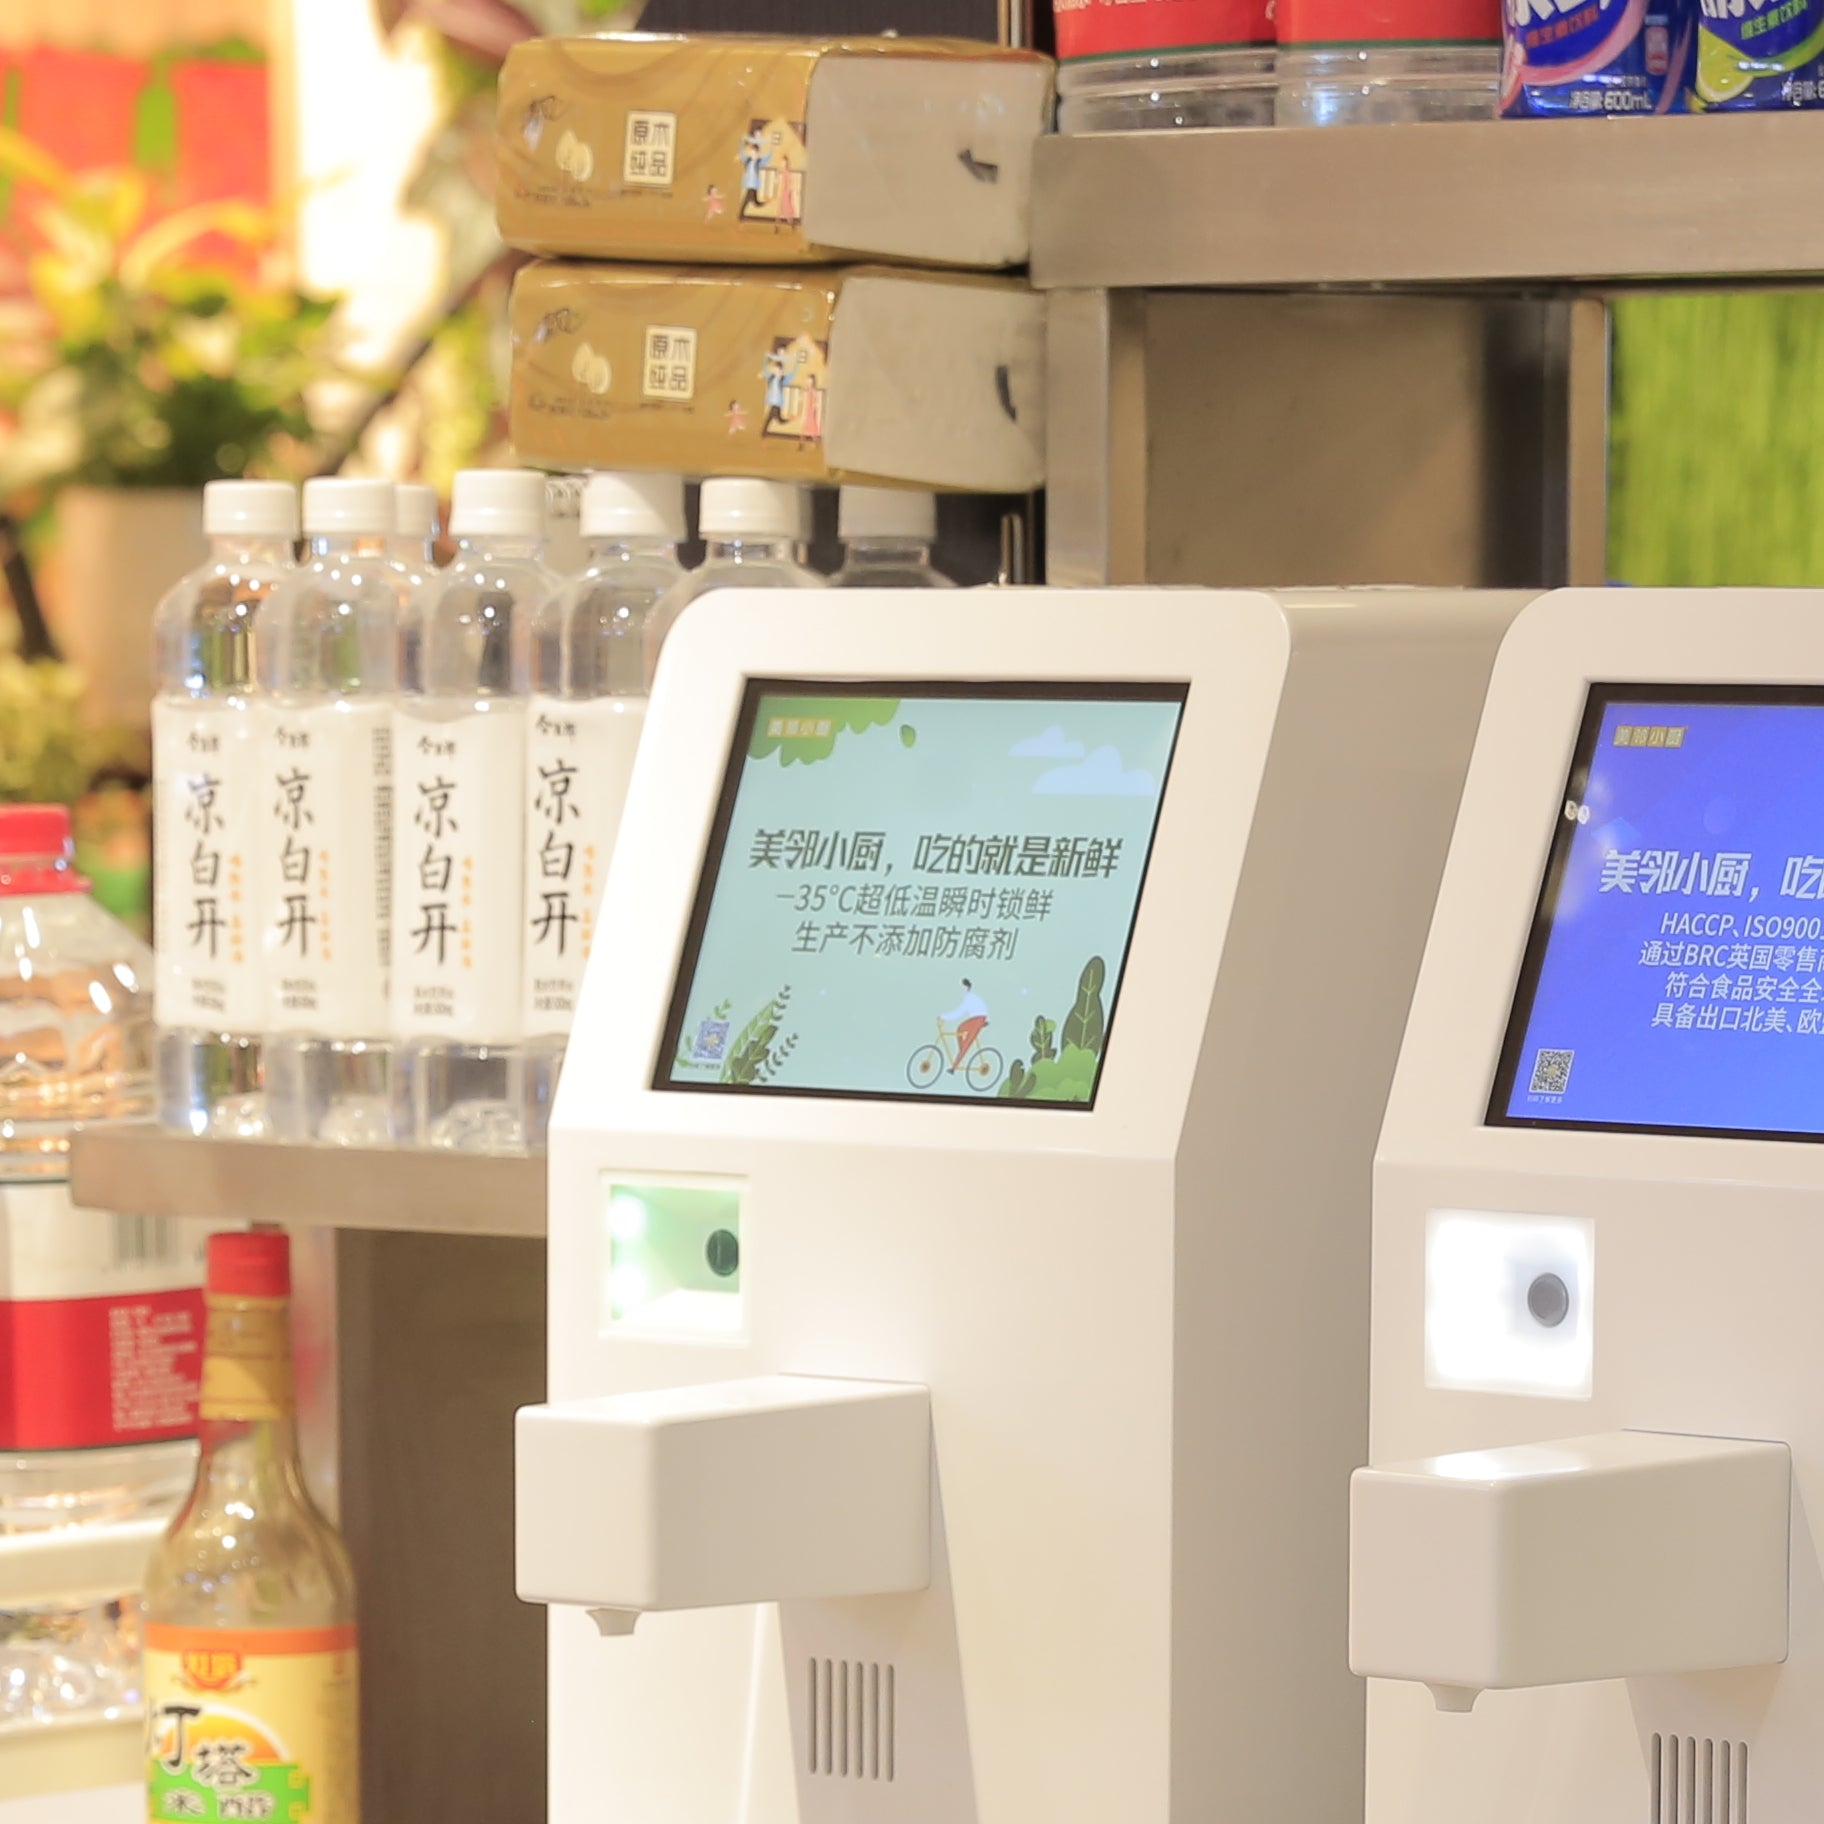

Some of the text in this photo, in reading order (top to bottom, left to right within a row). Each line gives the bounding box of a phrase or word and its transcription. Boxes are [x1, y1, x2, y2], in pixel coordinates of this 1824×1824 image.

[749, 828, 1124, 879] 美邻小厨，吃的就是新鲜
[790, 921, 1019, 962] 生产不添加防腐剂
